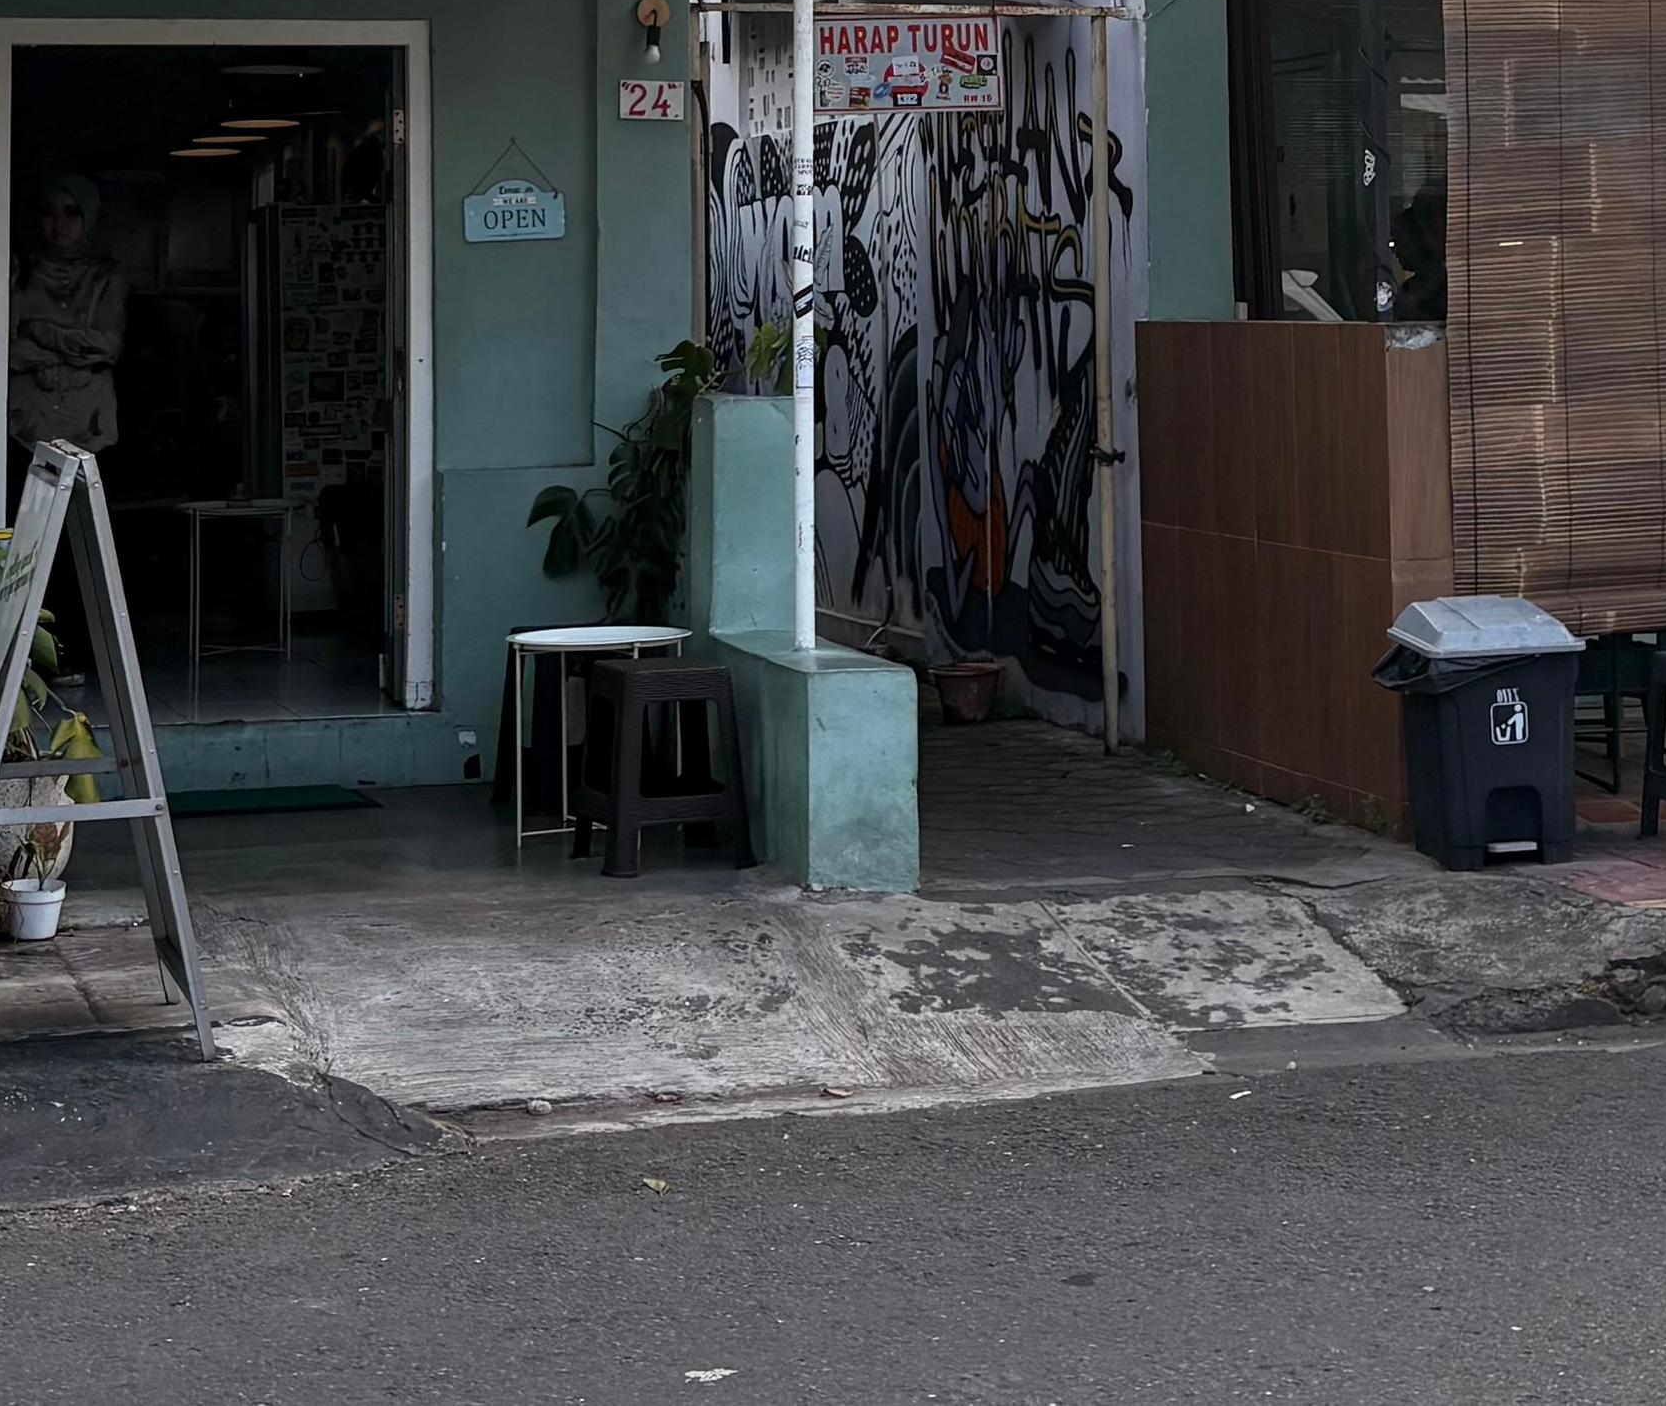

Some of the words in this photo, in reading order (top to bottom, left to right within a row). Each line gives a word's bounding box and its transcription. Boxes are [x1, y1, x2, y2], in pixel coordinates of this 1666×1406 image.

[819, 24, 899, 55] HARAP
[907, 22, 989, 53] TURUN
[483, 208, 546, 230] OPEN
